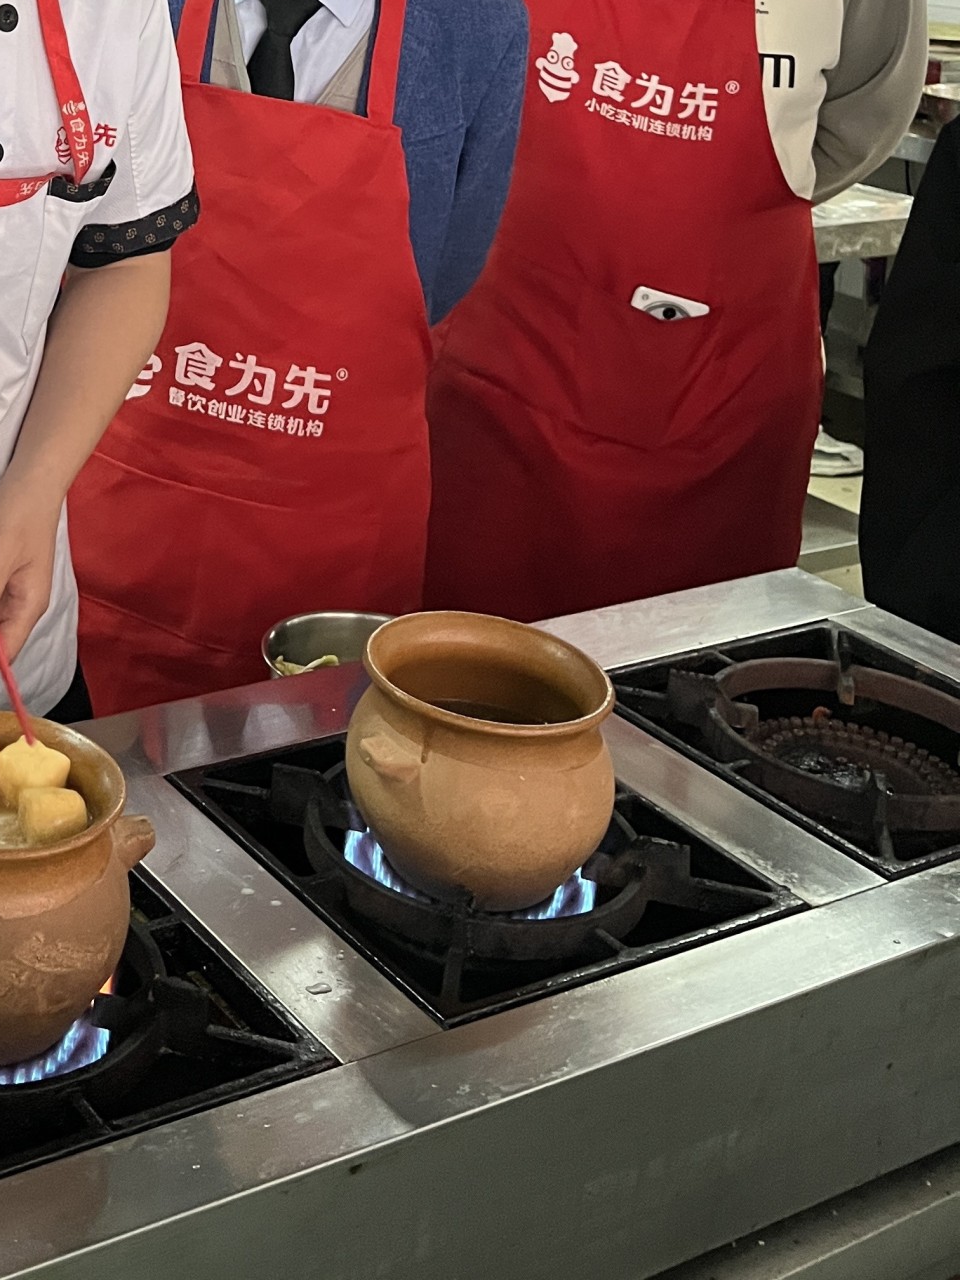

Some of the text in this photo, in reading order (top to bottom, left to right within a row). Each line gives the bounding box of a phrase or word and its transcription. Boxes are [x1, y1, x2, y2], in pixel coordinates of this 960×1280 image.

[591, 60, 719, 122] 食为先
[69, 117, 90, 168] 食为先
[93, 122, 118, 148] 先
[584, 97, 714, 142] 小吃实训连锁机构
[174, 341, 332, 415] 食为先
[168, 386, 324, 437] 餐饮创业连锁机构
